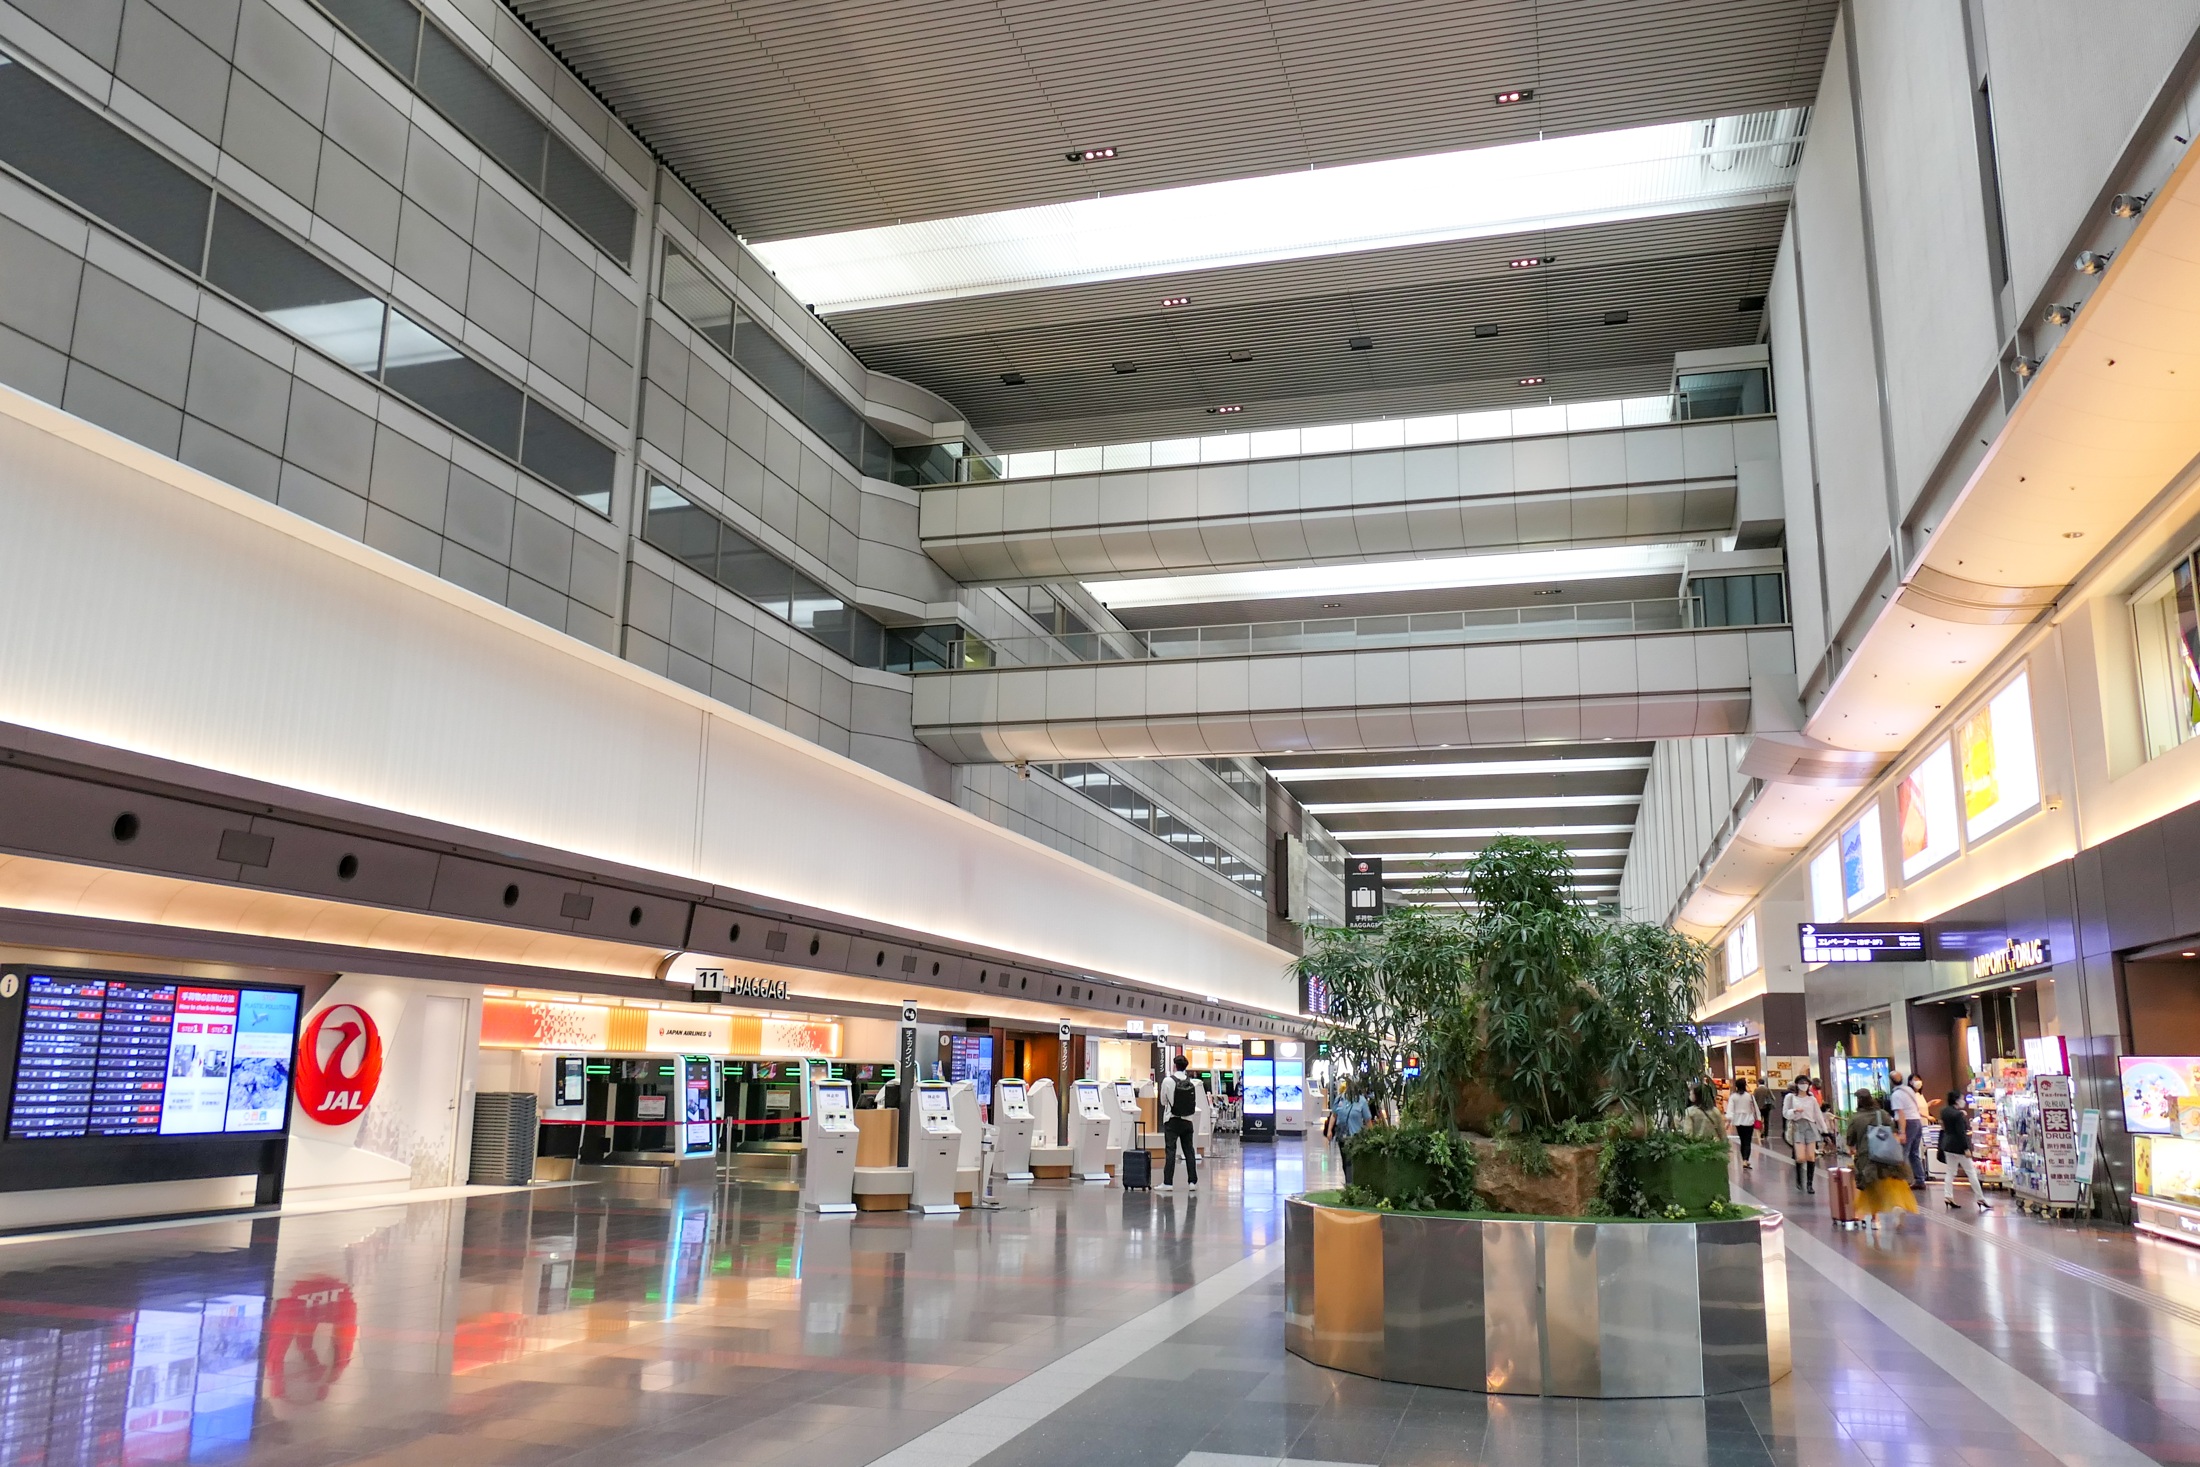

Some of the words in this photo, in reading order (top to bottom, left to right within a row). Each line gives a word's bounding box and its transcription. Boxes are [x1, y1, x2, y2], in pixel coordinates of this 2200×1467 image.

[1974, 948, 2007, 978] AIRPORT
[2015, 938, 2043, 969] DRUG
[699, 971, 718, 988] 11
[734, 974, 791, 1000] BAGGAGE
[905, 1030, 913, 1069] チェックイン
[317, 1091, 363, 1111] JAL
[2045, 1110, 2068, 1130] 薬
